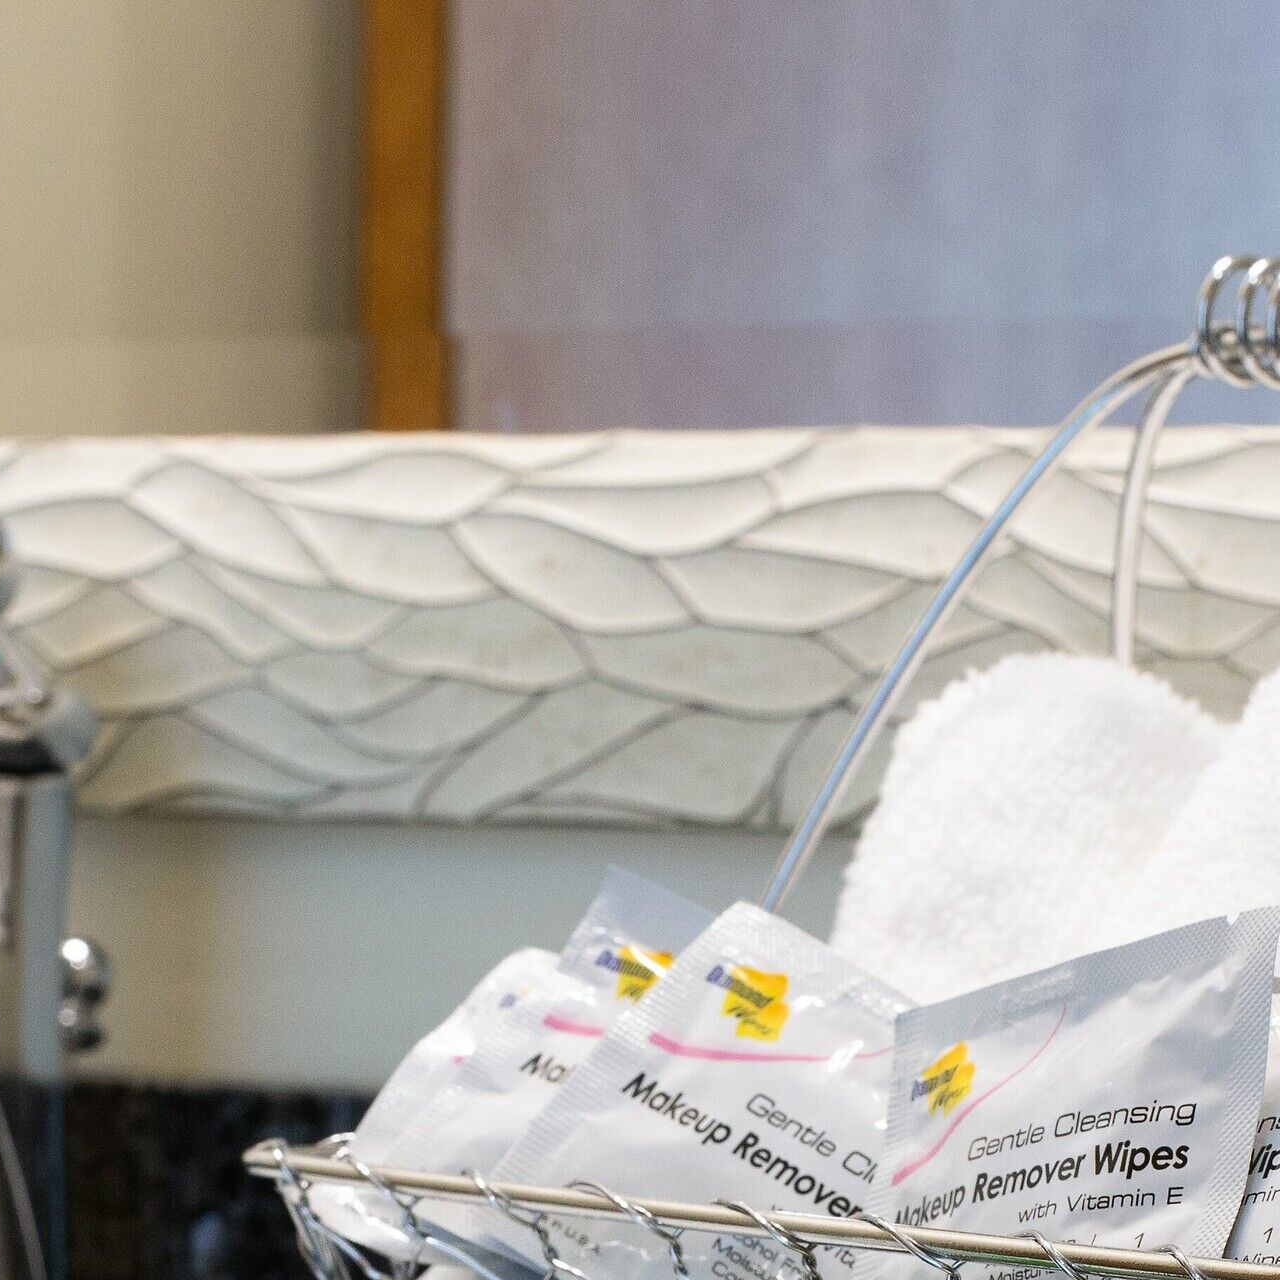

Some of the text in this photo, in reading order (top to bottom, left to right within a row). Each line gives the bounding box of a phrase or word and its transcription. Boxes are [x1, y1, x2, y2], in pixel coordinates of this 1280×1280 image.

[622, 1072, 732, 1145] Makeup
[746, 1093, 837, 1157] Gentle
[968, 1100, 1197, 1160] Gentle Cleansing
[972, 1153, 1086, 1204] Remover
[1094, 1141, 1190, 1180] Wipes
[1018, 1186, 1185, 1224] with Vitamin E
